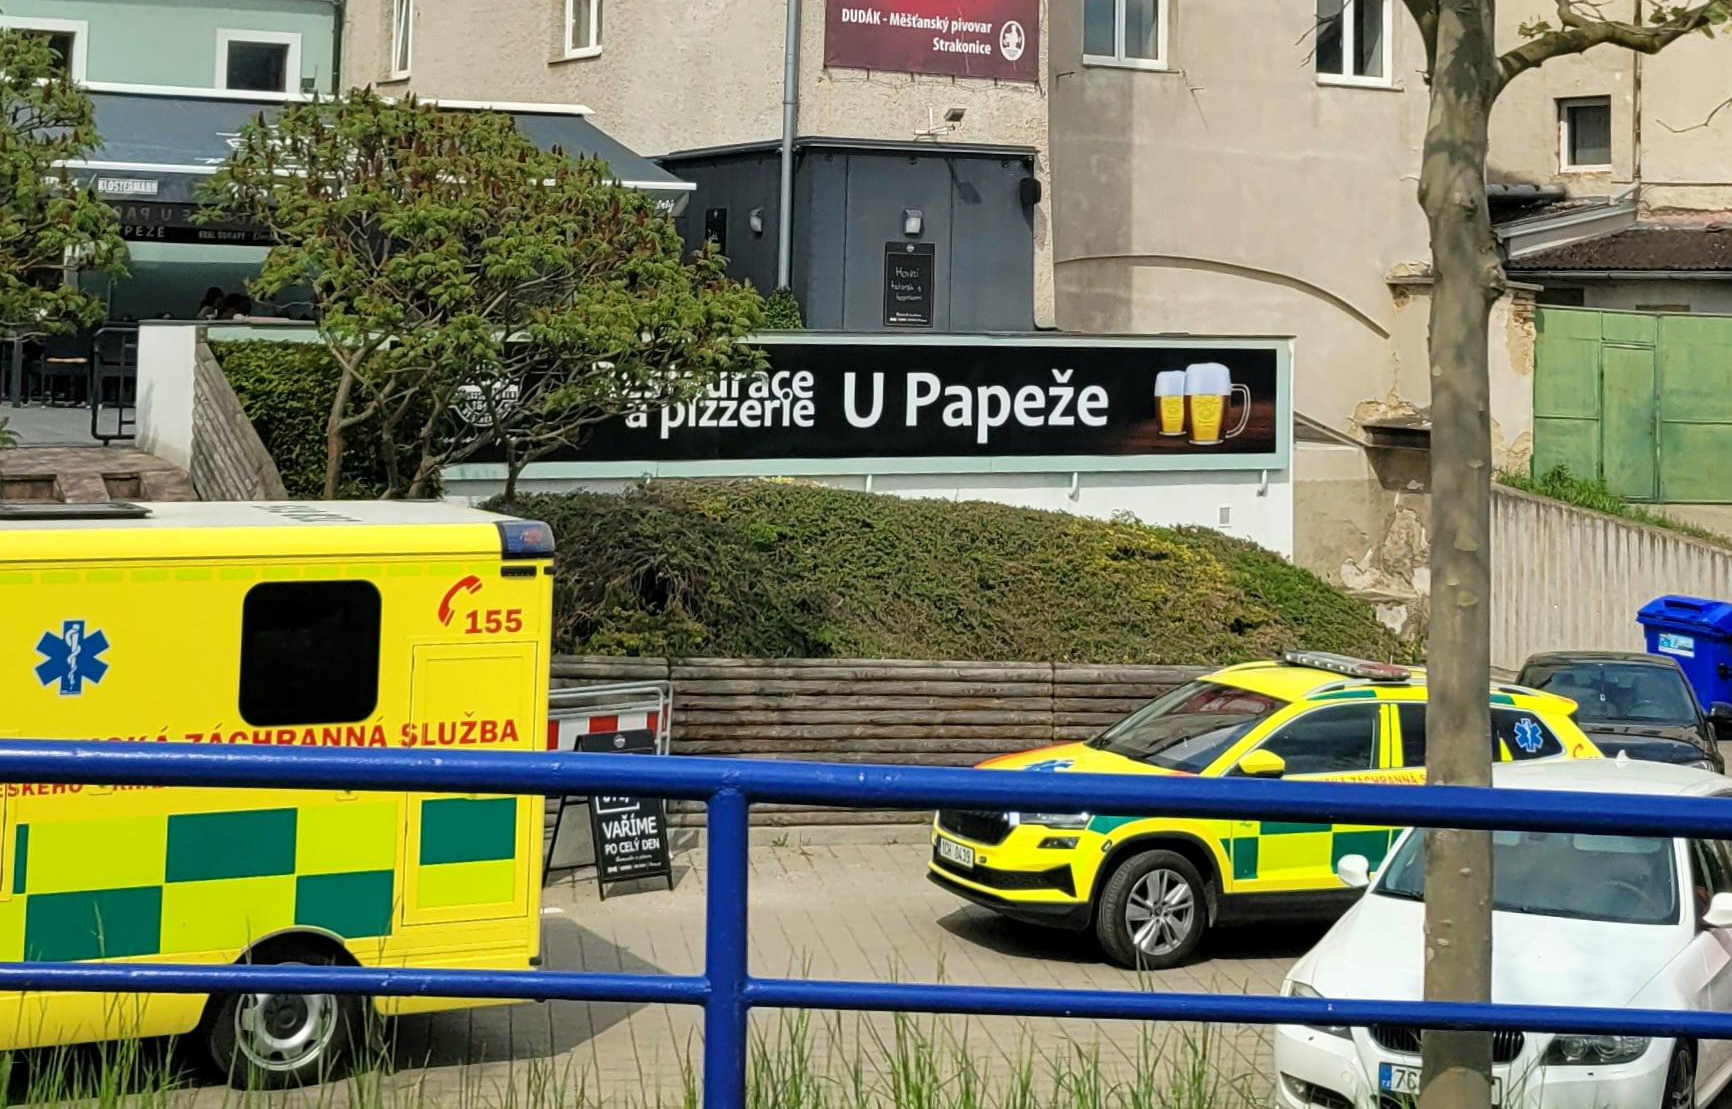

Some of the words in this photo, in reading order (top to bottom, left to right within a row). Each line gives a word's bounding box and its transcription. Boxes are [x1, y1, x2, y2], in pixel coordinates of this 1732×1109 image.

[841, 7, 881, 25] DUDÁK
[889, 12, 949, 33] Měšťanský
[951, 17, 993, 34] pivovar
[932, 37, 992, 55] Strakonice
[660, 389, 814, 439] pizzerie
[843, 372, 885, 429] U
[905, 368, 1110, 445] Papeže
[465, 609, 523, 634] 155
[401, 711, 519, 747] SLUŽBA
[602, 813, 658, 839] VAŘÍME
[605, 842, 618, 855] PO
[619, 836, 640, 853] CELÝ
[641, 837, 660, 851] DEN
